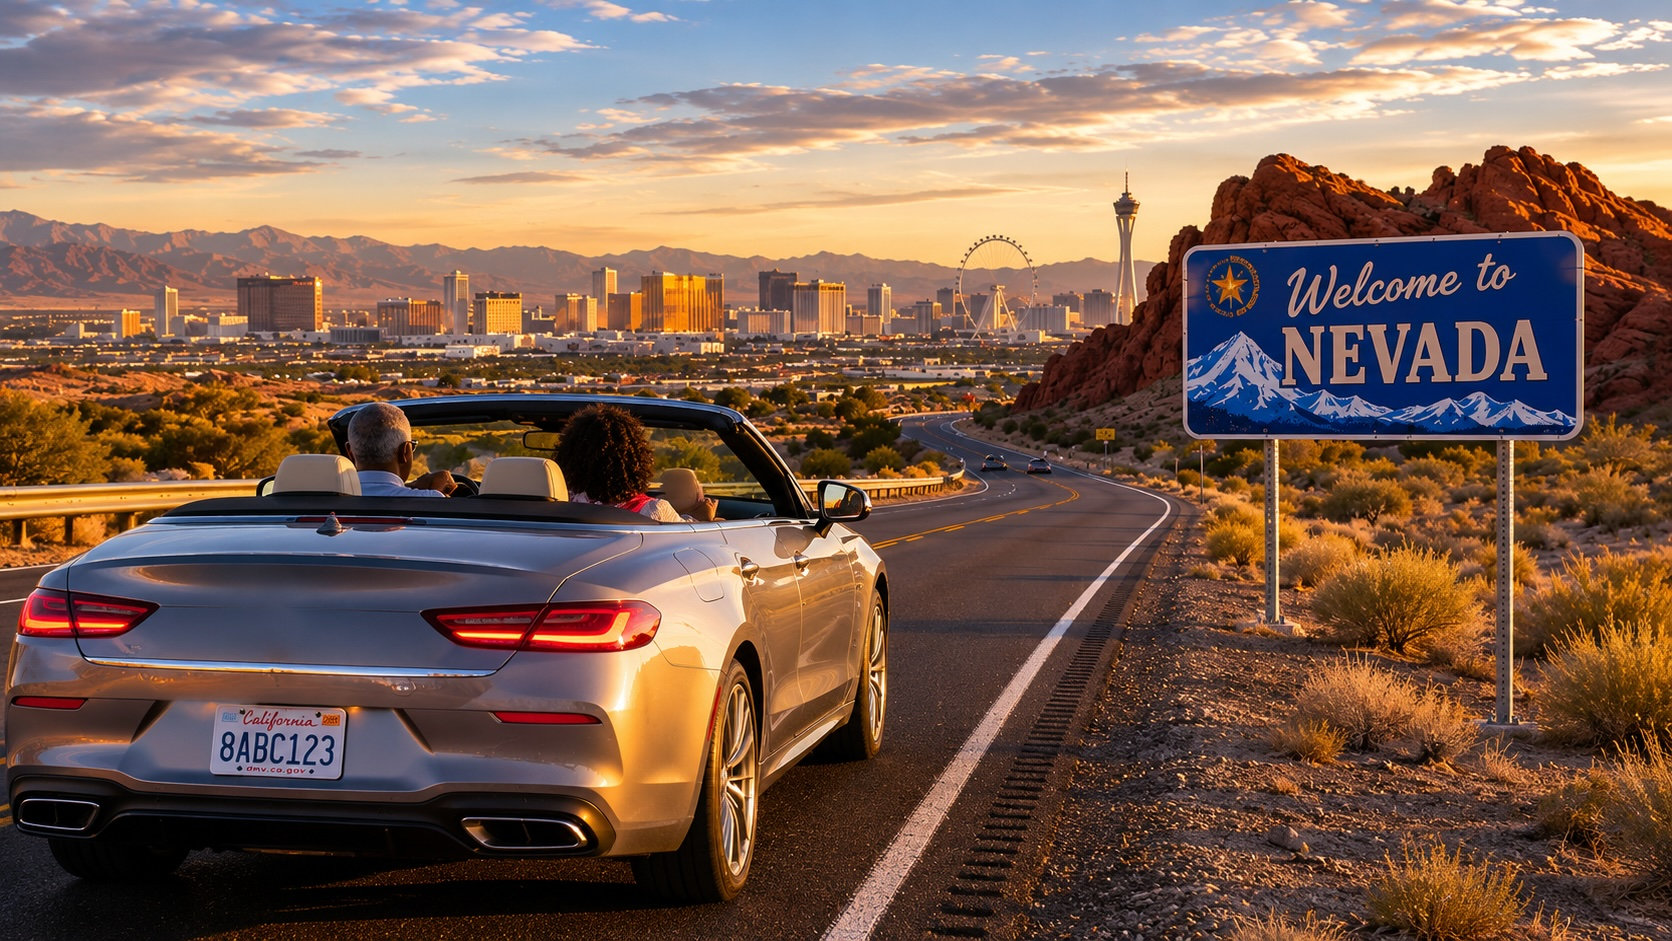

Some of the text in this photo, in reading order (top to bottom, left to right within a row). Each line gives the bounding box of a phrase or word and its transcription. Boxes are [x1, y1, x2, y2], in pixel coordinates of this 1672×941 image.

[1287, 261, 1461, 317] Welcome
[1477, 253, 1516, 291] to
[1281, 319, 1547, 386] NEVADA
[243, 710, 318, 731] California
[220, 731, 335, 766] 8ABC123
